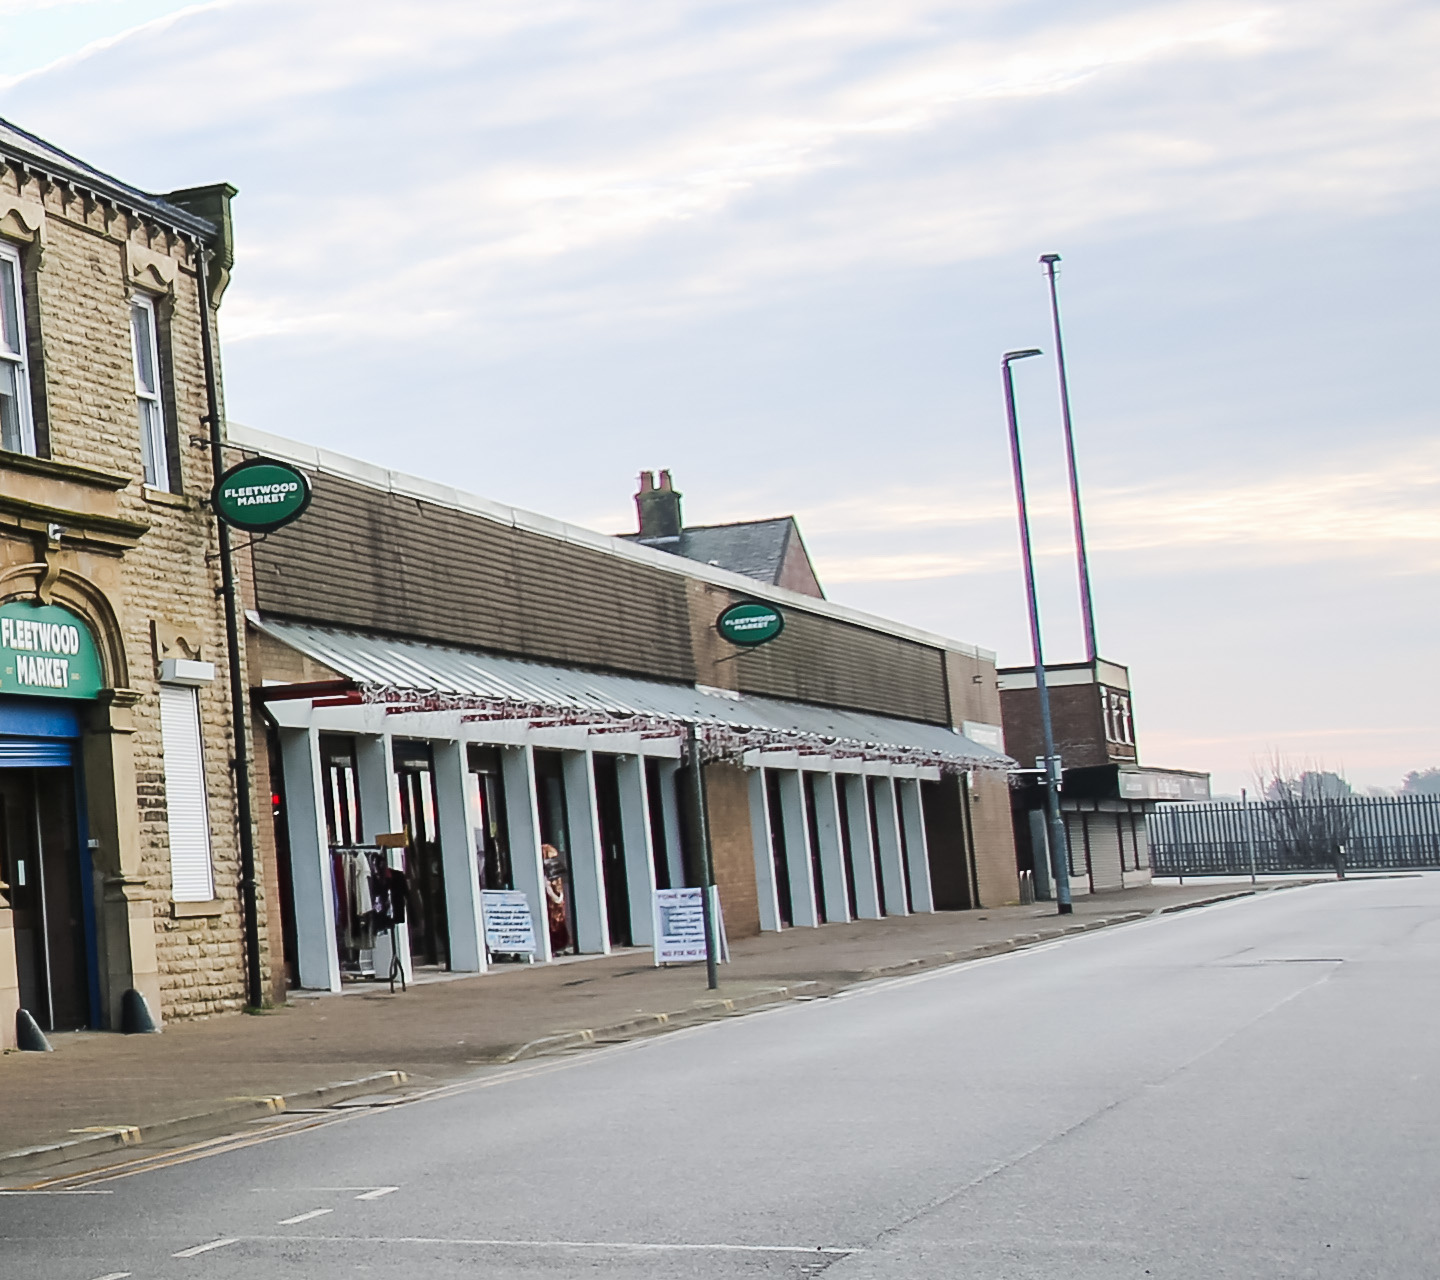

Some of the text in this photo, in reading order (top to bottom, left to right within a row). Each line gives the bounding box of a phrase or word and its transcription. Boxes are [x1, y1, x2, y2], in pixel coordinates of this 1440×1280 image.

[224, 483, 298, 498] FLEETWOOD
[237, 493, 286, 506] MARKET
[1, 618, 79, 655] FLEETWOOD
[16, 654, 68, 688] MARKET
